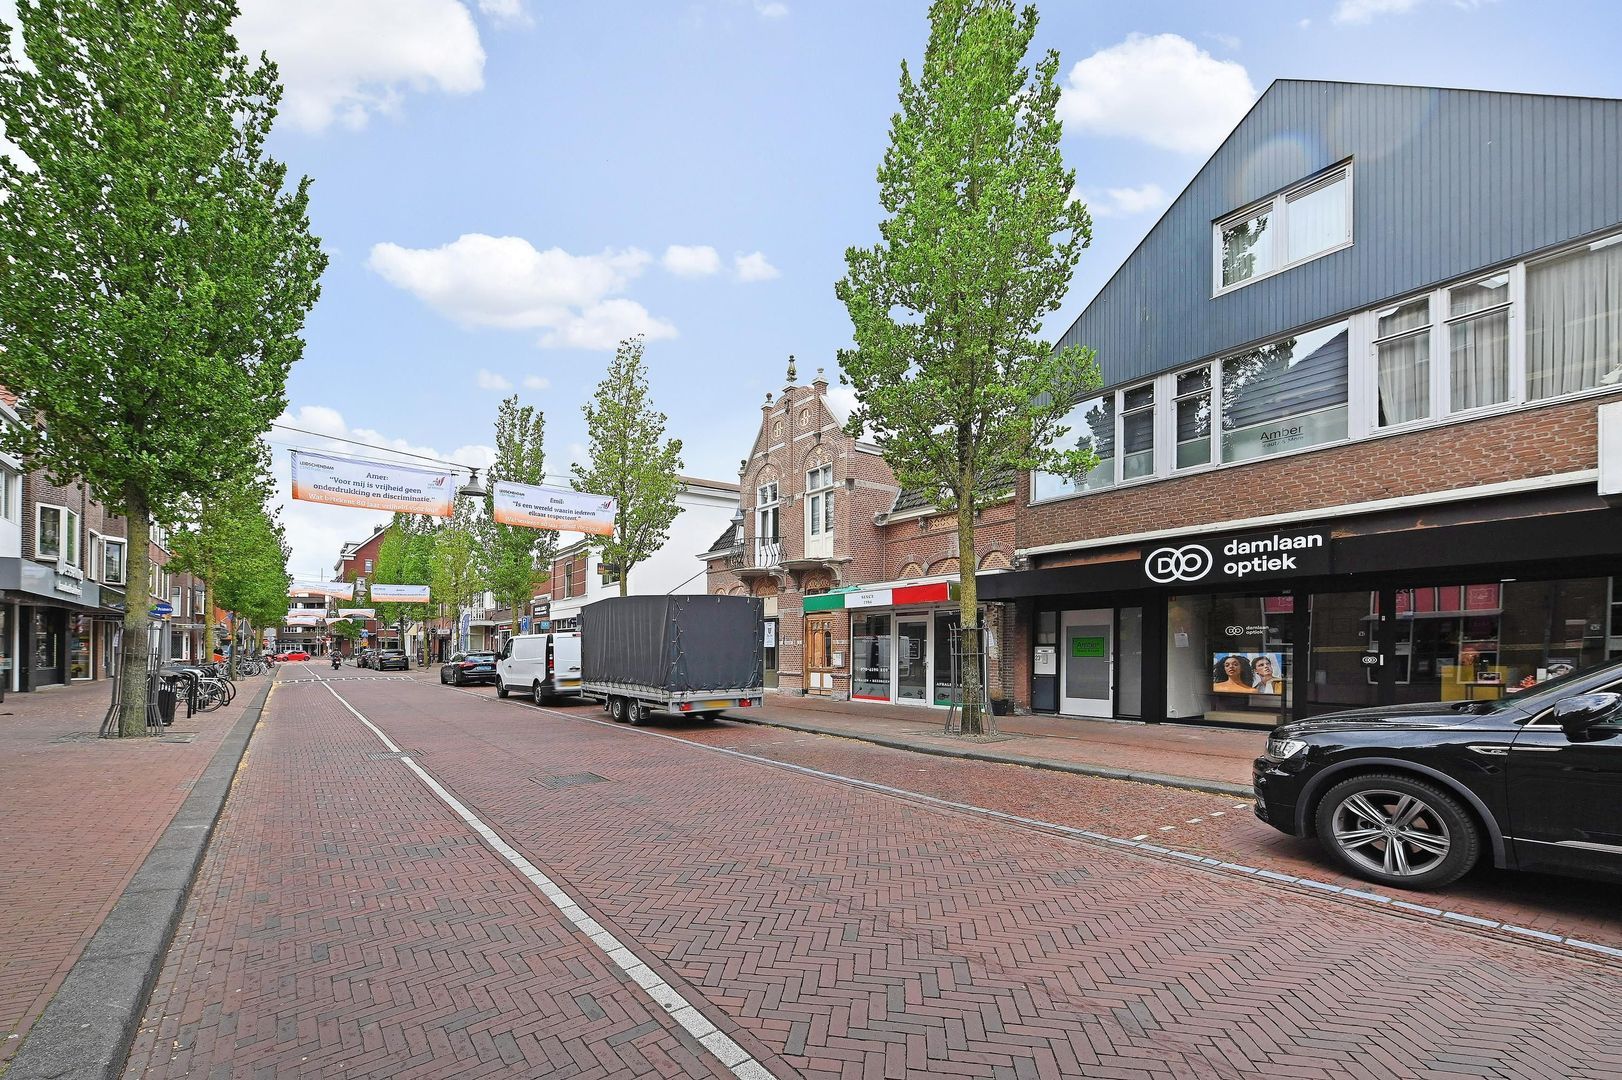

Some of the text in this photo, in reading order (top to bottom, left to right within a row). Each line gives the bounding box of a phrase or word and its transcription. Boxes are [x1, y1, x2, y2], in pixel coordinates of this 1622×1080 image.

[1260, 426, 1304, 440] Amber
[366, 472, 388, 481] Amer:
[313, 484, 371, 498] onderdrukking
[353, 480, 365, 488] mij
[376, 482, 403, 493] vrijheid
[405, 486, 422, 495] geen
[1224, 534, 1323, 556] damlaan
[1224, 554, 1297, 577] optiek
